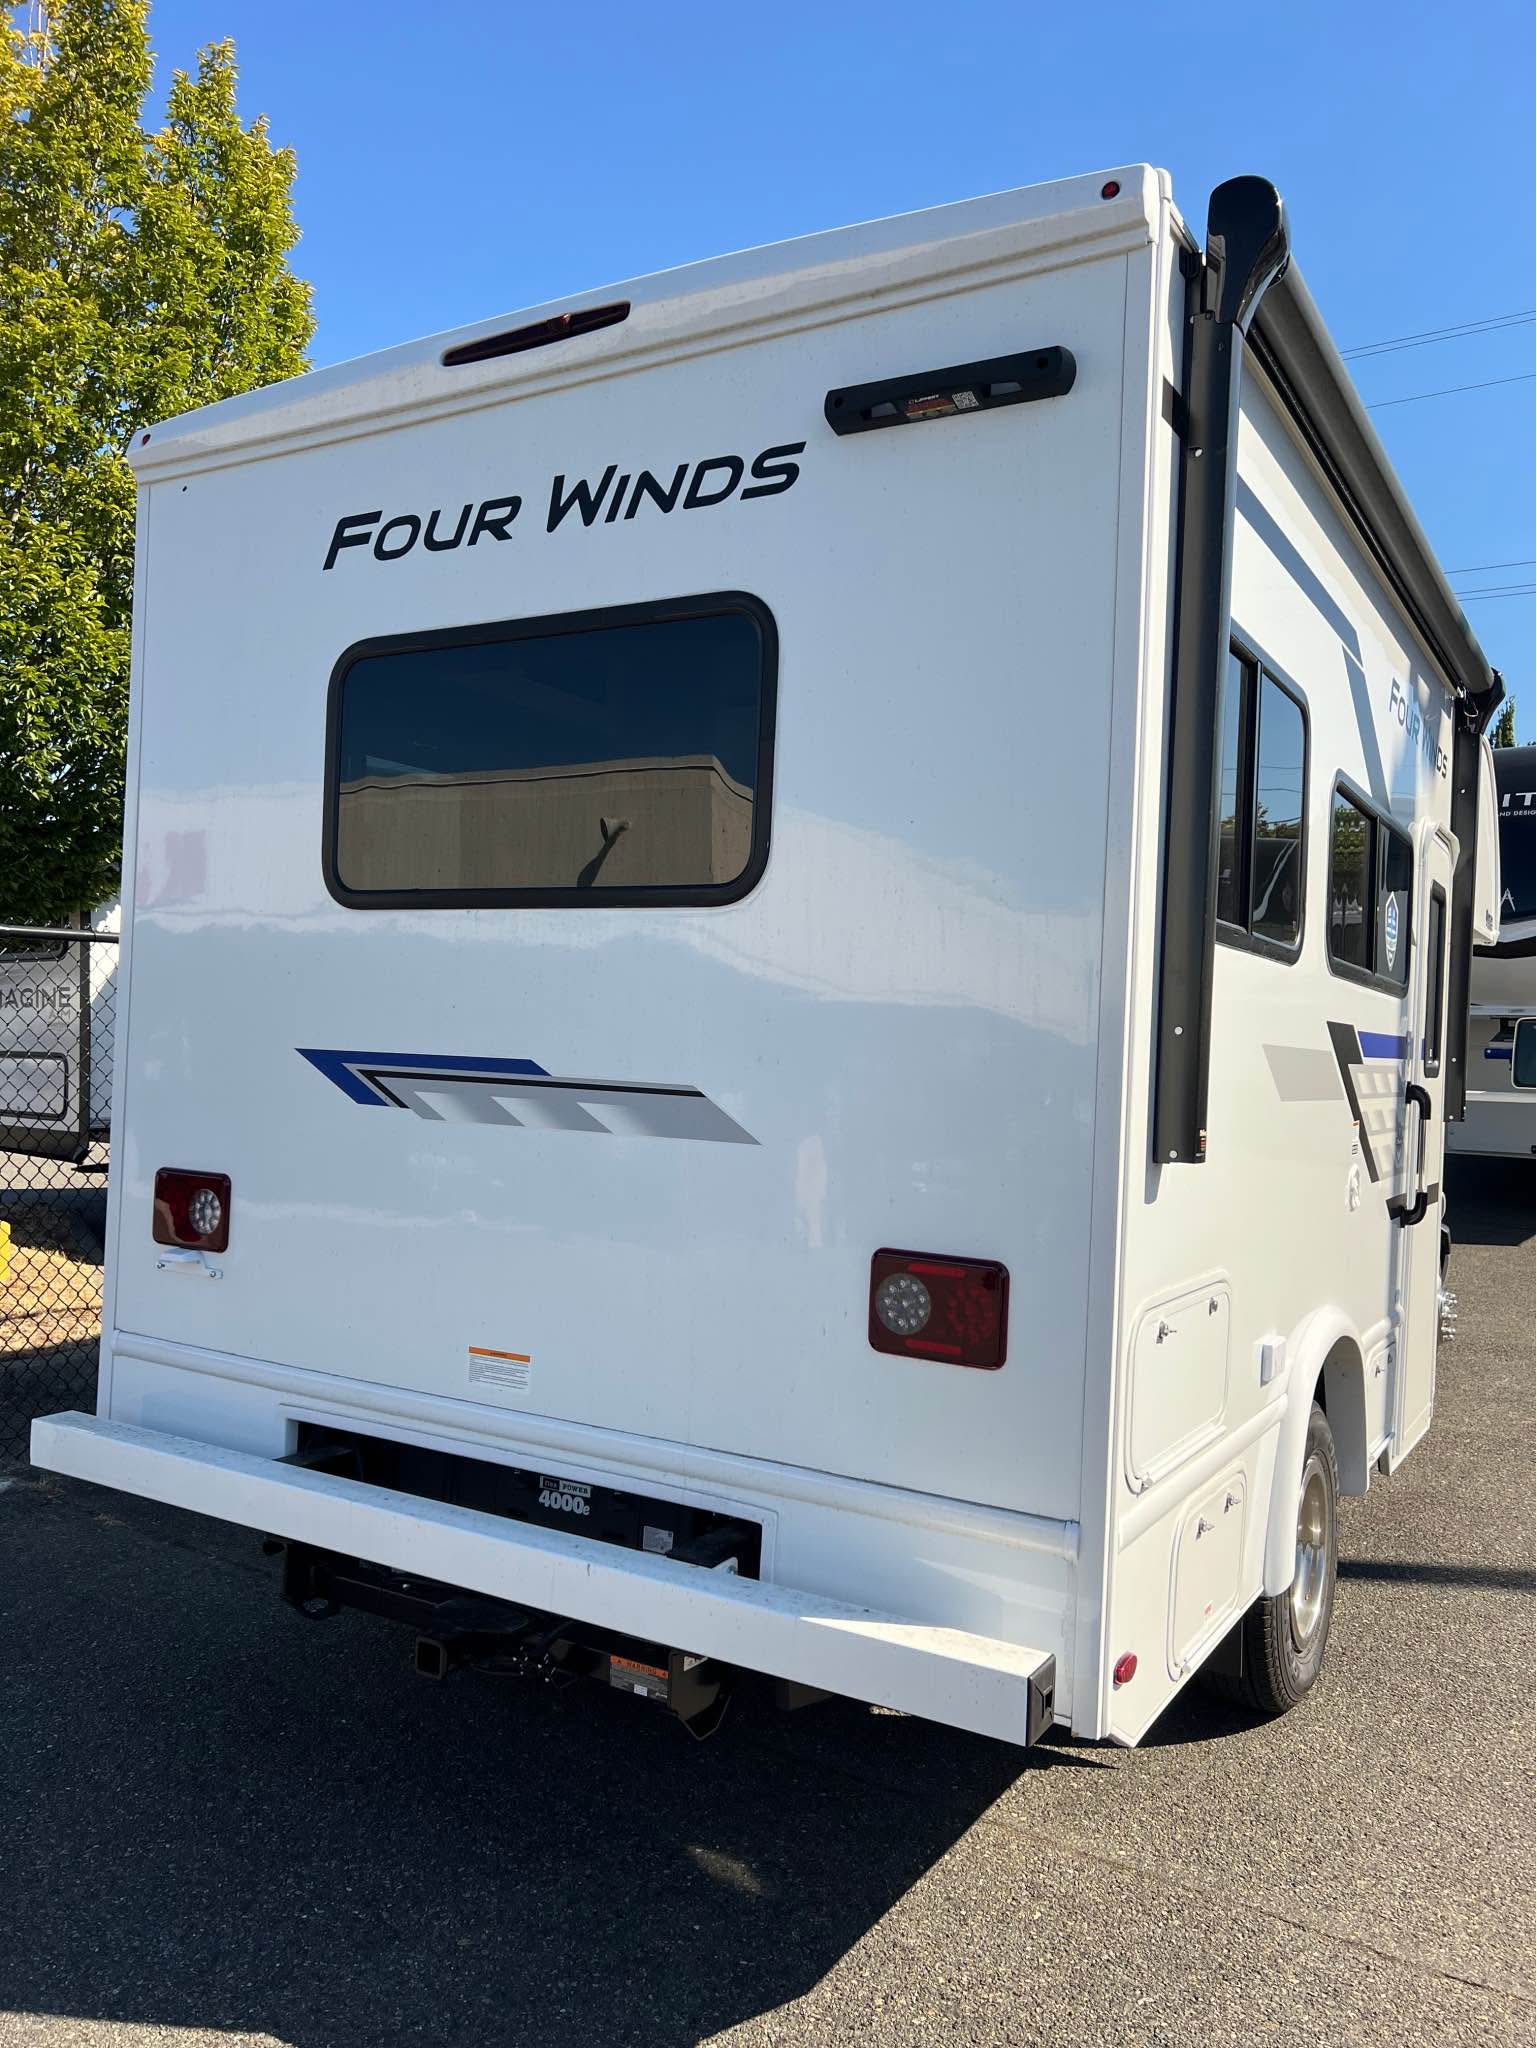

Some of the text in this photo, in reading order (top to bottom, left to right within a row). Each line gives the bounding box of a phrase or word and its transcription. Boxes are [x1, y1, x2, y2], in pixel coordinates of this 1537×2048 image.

[323, 441, 807, 571] FOUR WINDS
[1389, 677, 1420, 745] FOUR
[0, 987, 70, 1008] AGINE
[538, 1489, 591, 1516] 4000e
[562, 1483, 589, 1495] POWER
